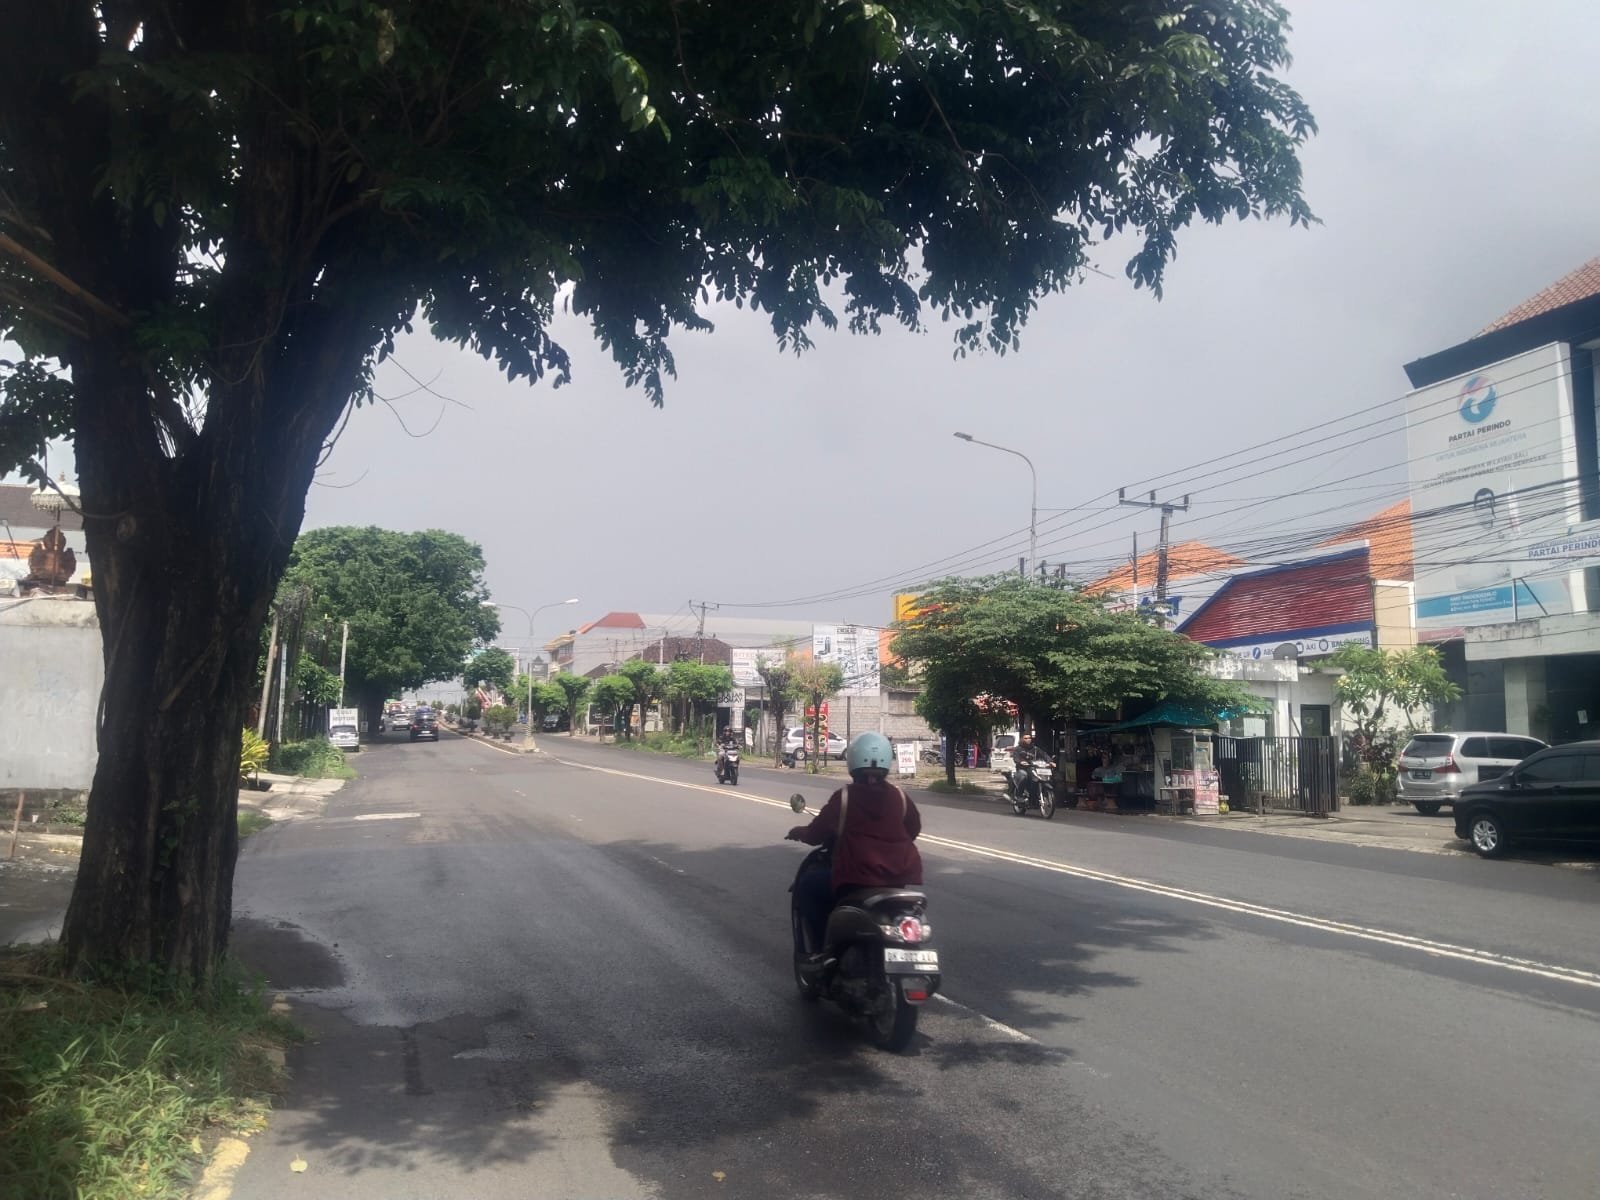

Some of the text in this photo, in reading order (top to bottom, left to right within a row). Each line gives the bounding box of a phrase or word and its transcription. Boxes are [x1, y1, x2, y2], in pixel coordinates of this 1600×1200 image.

[1448, 430, 1475, 442] PARTAI
[1477, 419, 1511, 435] PERINDO
[1528, 546, 1560, 558] PARTAI
